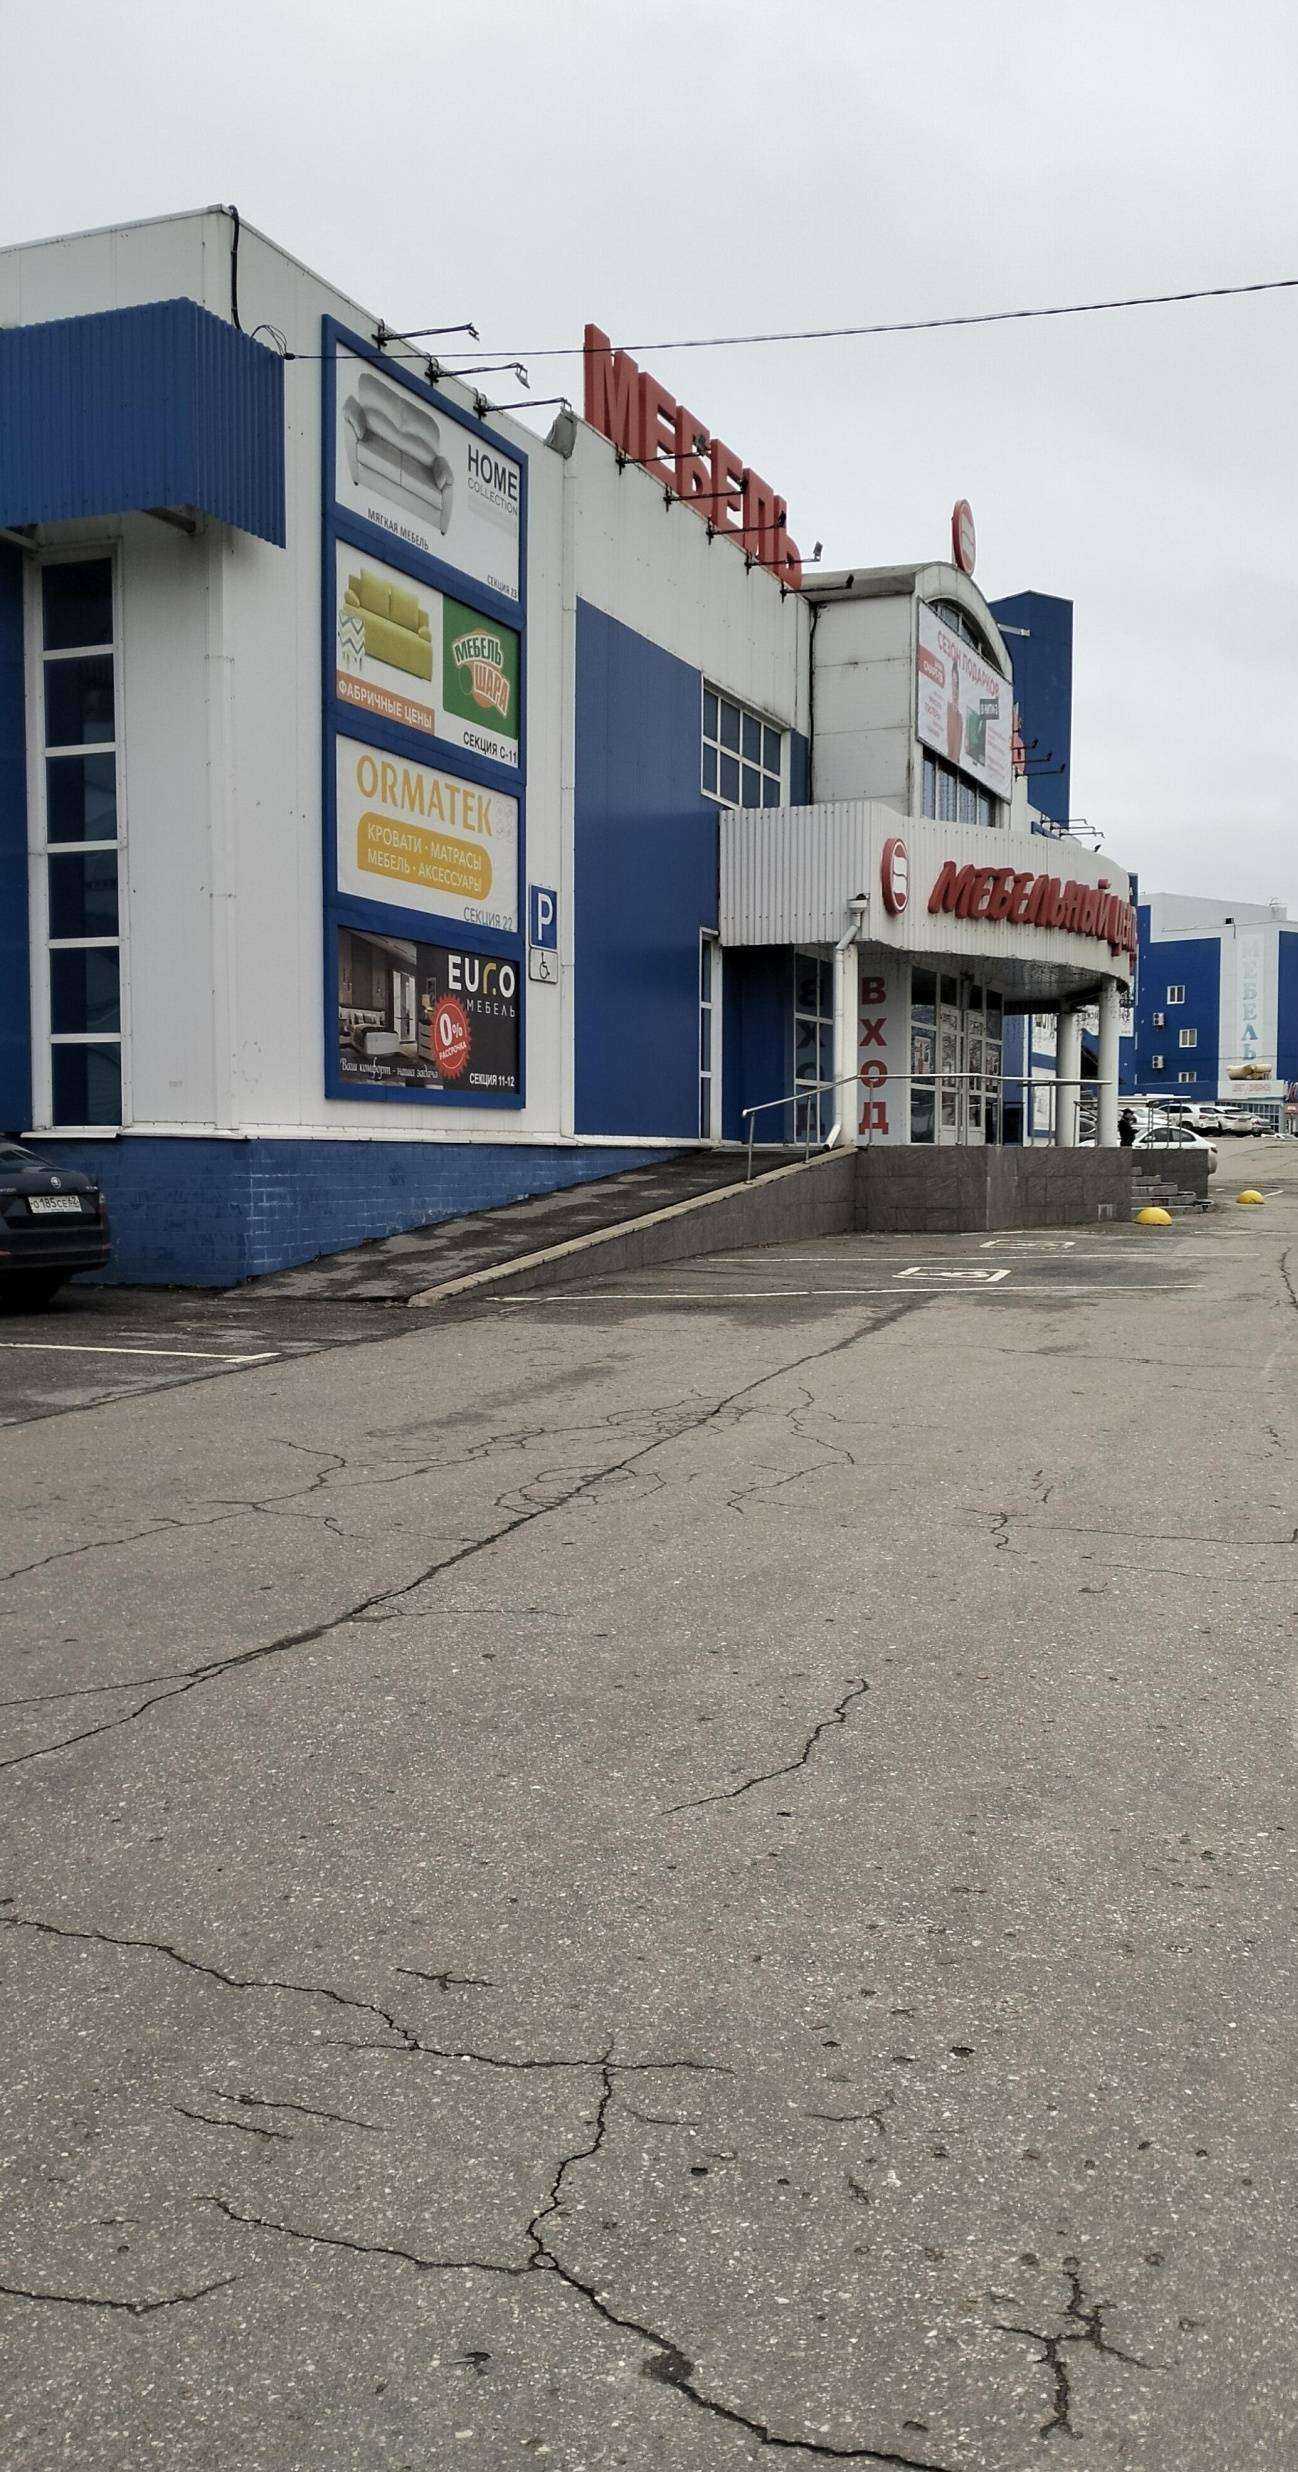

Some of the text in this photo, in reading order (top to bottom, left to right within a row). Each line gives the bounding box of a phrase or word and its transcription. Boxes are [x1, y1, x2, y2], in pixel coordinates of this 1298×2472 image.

[468, 444, 517, 501] HOME
[584, 323, 802, 590] МЕБЕЛЬ
[468, 477, 518, 516] COLLECTION
[368, 507, 430, 550] МЯГКАЯ МЕБЕЛЬ
[487, 574, 510, 595] СЕКЦИЯ
[454, 636, 503, 668] МЕБЕЛЬ
[338, 680, 432, 729] ФАБРИЧНЫЕ ЦЕНЫ
[463, 732, 518, 764] СЕКЦИЯ С-11
[357, 754, 493, 837] ORMATEK
[368, 823, 482, 871] КРОВАТИ МАТРАСЫ
[368, 848, 482, 893] МЕБЕЛЬ АКСЕССУАРЫ
[463, 906, 513, 931] СЕКЦИЯ 22
[538, 892, 553, 940] P
[928, 860, 1112, 941] МЕБЕЛЬНЫЙ
[439, 1013, 463, 1047] 0%
[466, 998, 516, 1018] МЕБЕЛЬ
[858, 976, 889, 1135] ВХОД
[469, 1072, 516, 1088] СЕКЦИЯ 11-12
